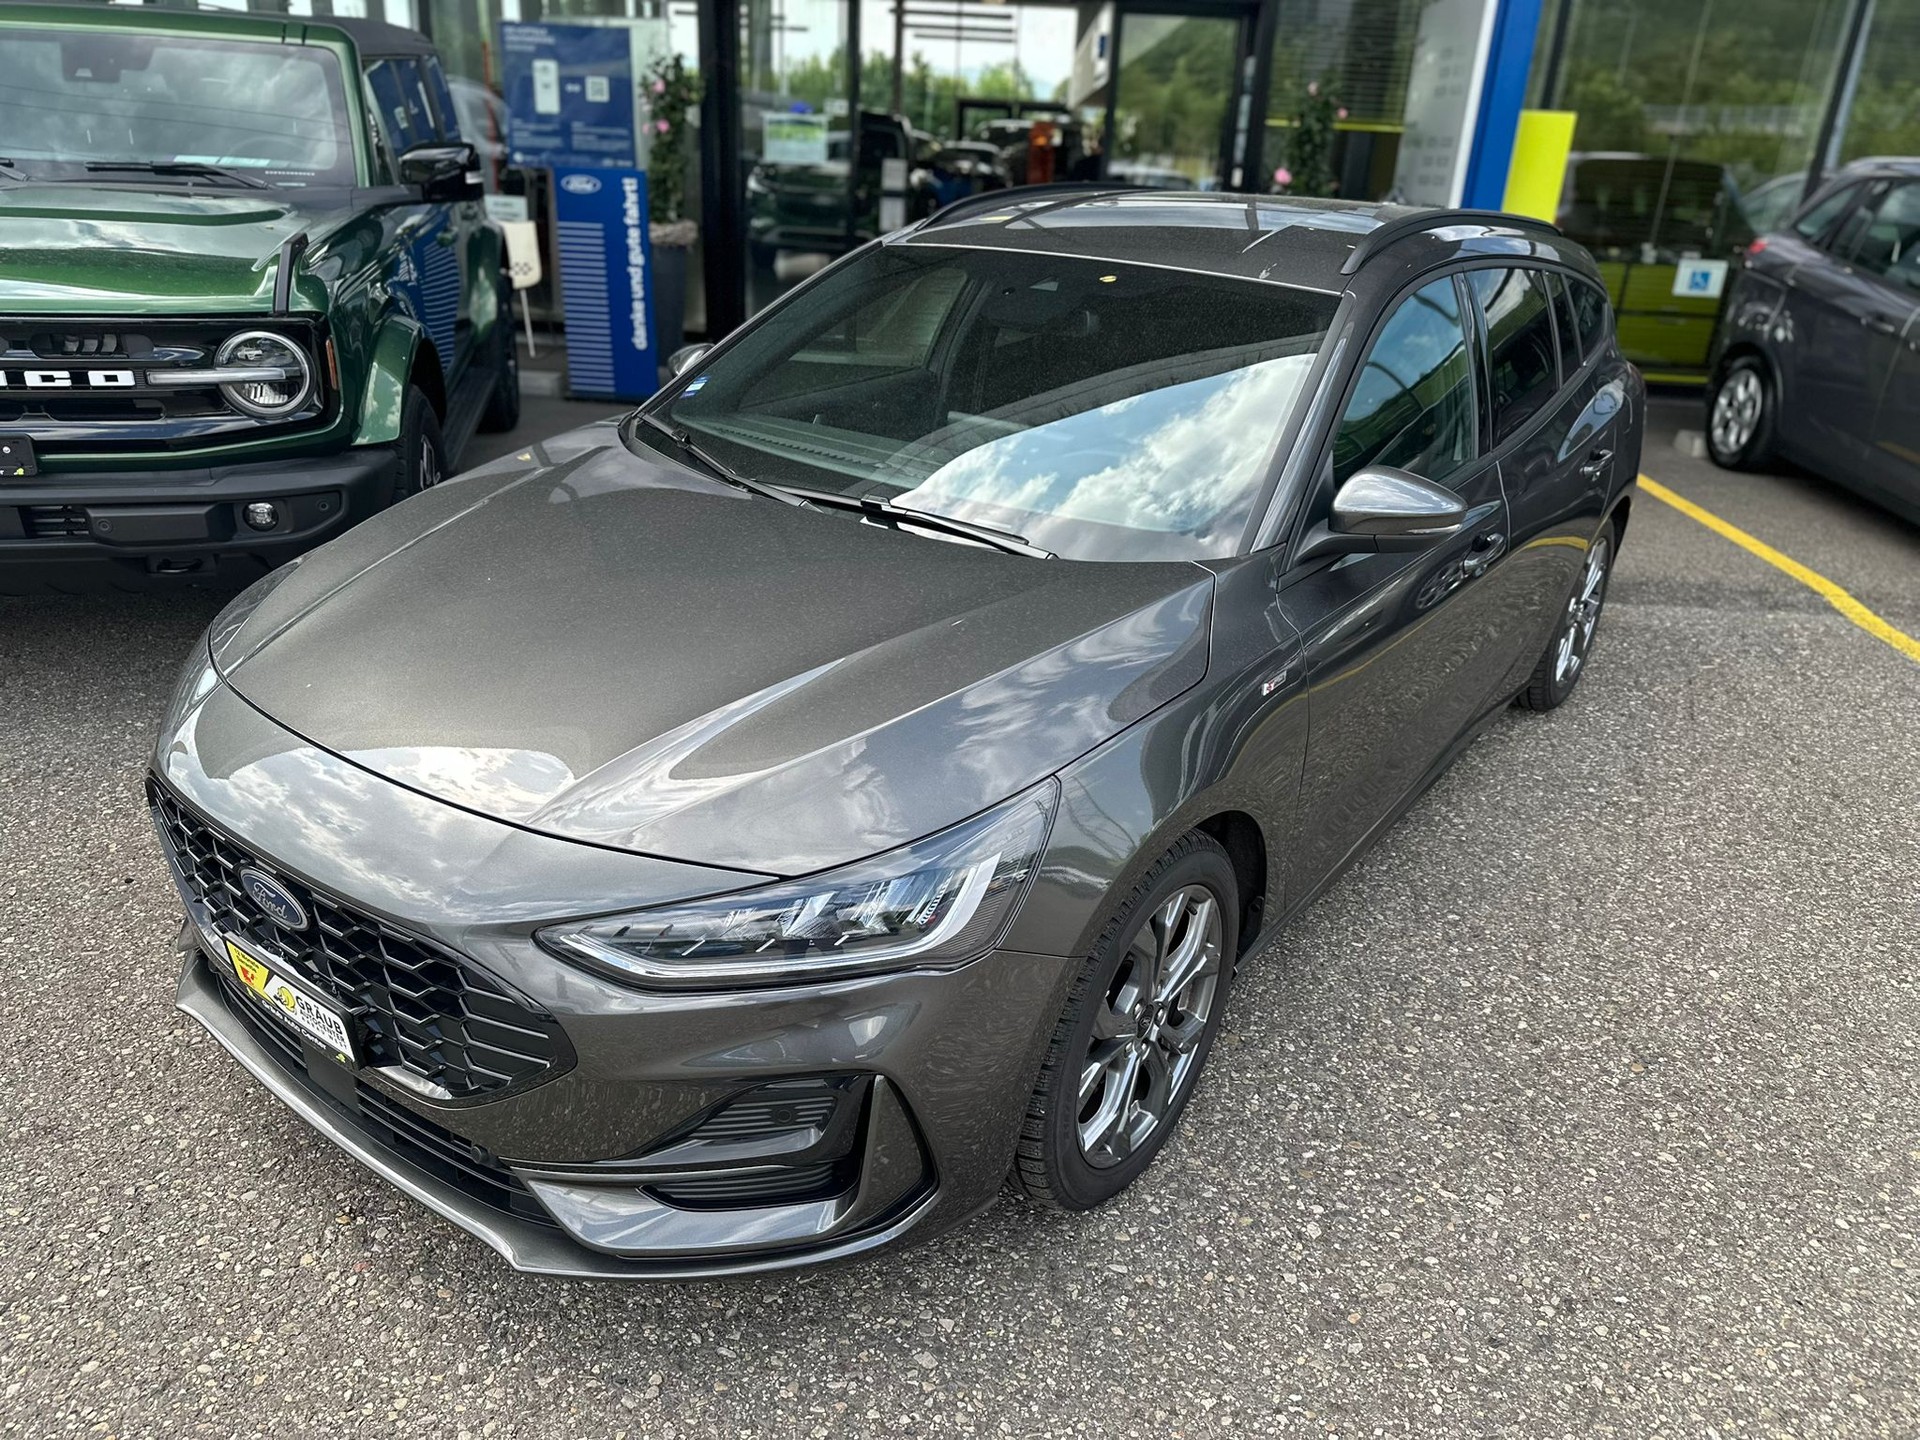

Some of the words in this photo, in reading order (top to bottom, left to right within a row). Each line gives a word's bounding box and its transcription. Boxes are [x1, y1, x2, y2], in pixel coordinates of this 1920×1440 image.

[626, 227, 645, 266] gute
[627, 266, 645, 299] und
[630, 300, 648, 350] danke
[0, 370, 135, 386] CO
[252, 881, 288, 920] Ford
[295, 995, 343, 1035] GRÄUB
